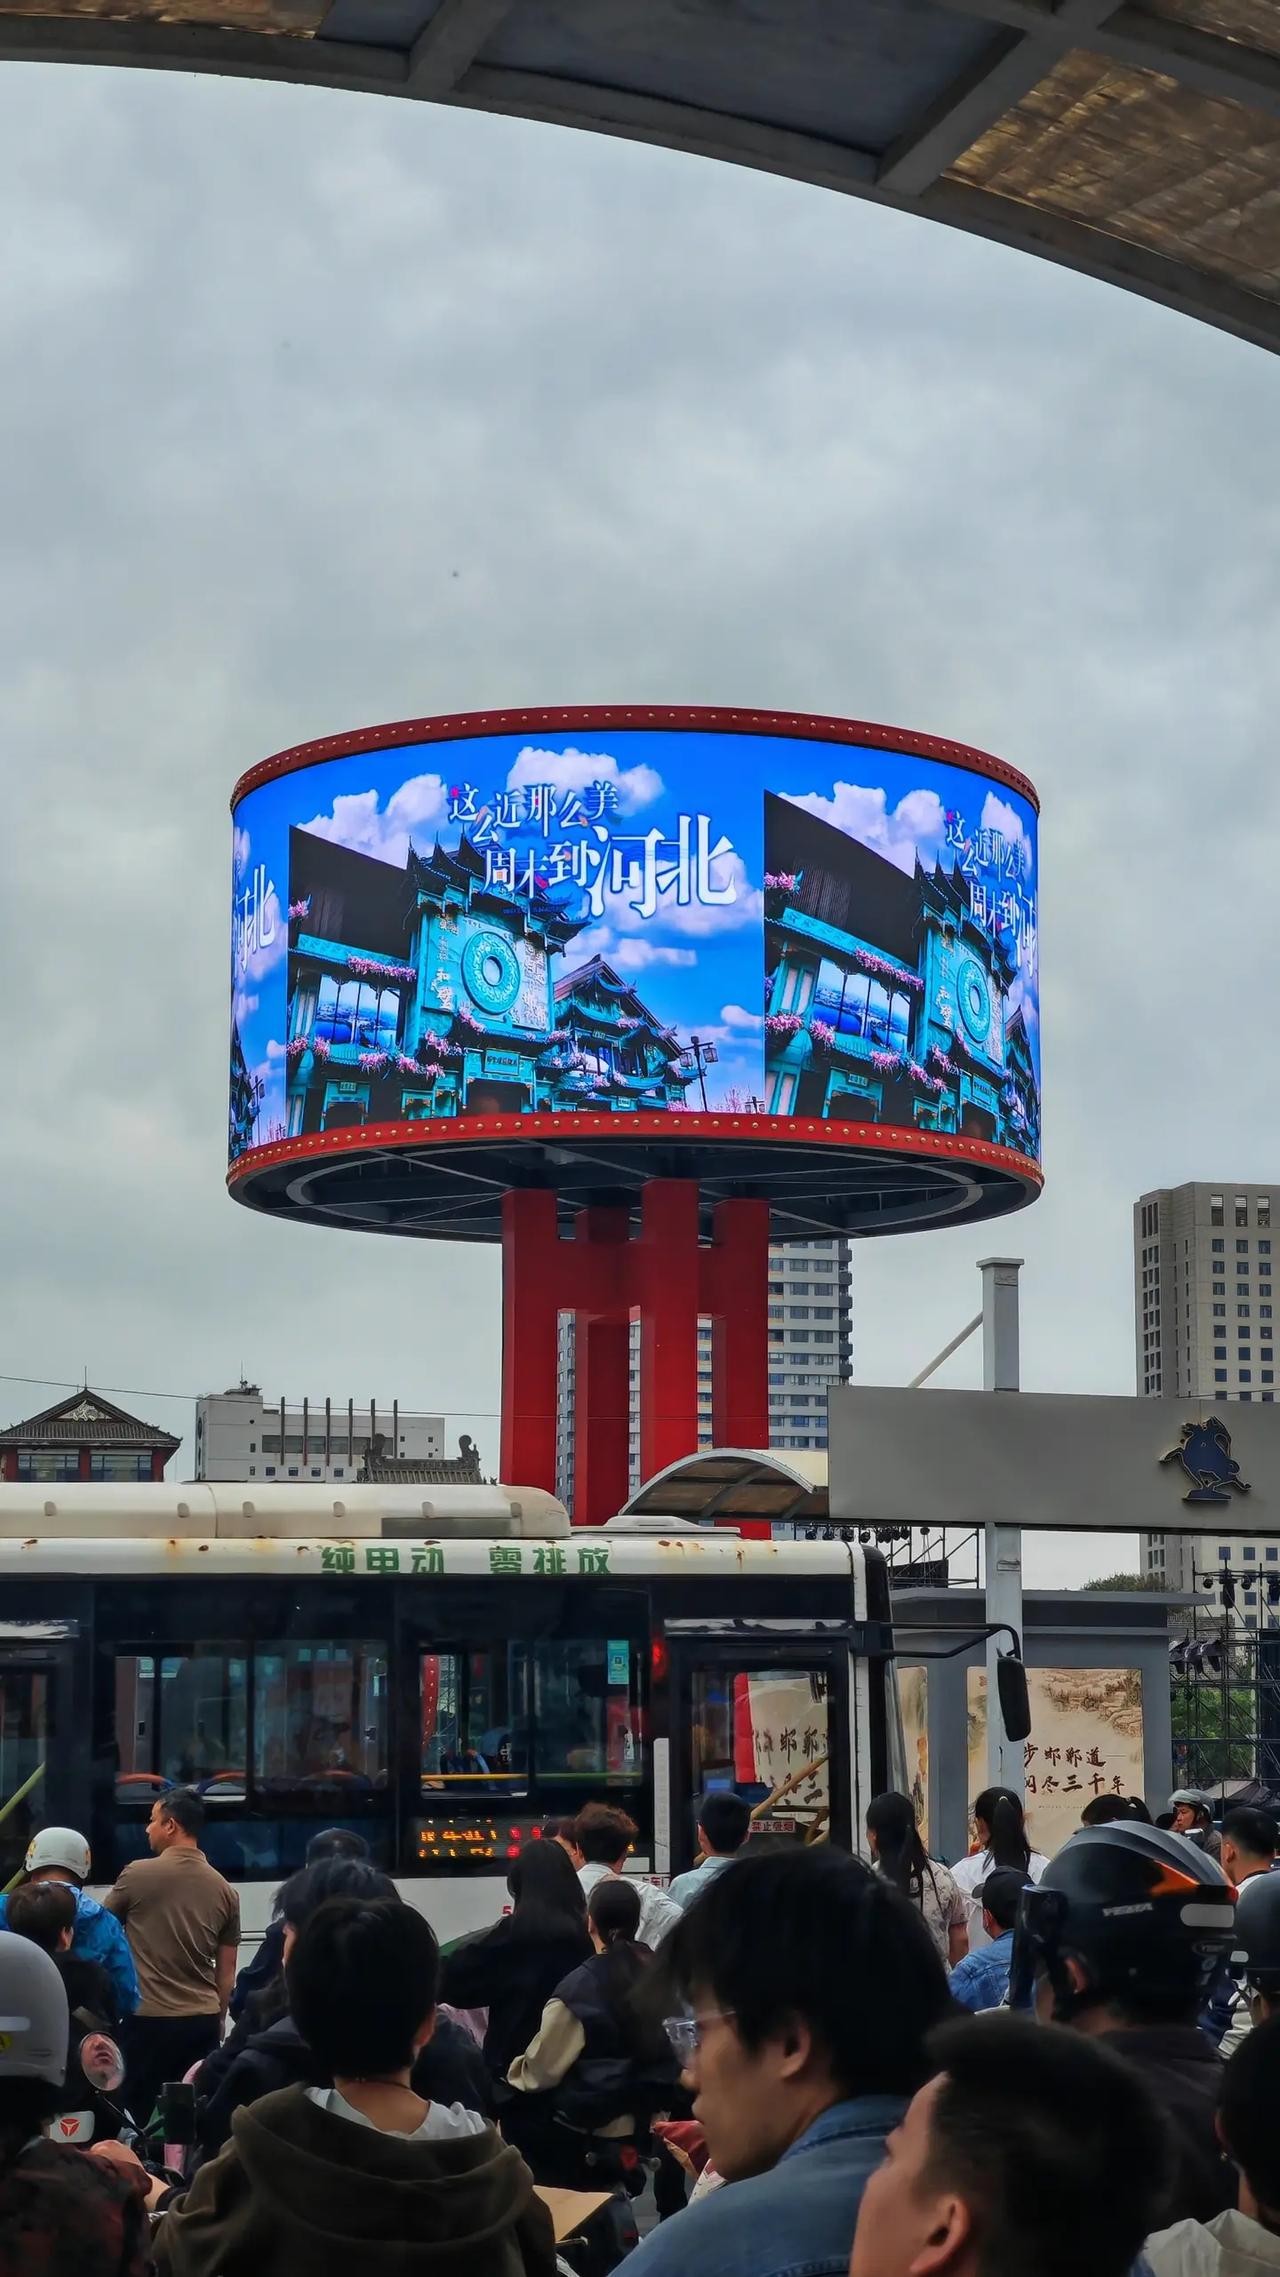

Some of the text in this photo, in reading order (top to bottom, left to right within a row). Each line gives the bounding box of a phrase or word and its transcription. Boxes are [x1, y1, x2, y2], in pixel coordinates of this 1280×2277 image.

[449, 781, 619, 844] 这么近那么美
[480, 814, 738, 919] 周末到河北
[321, 1547, 445, 1574] 纯电动
[489, 1547, 611, 1574] 零排放
